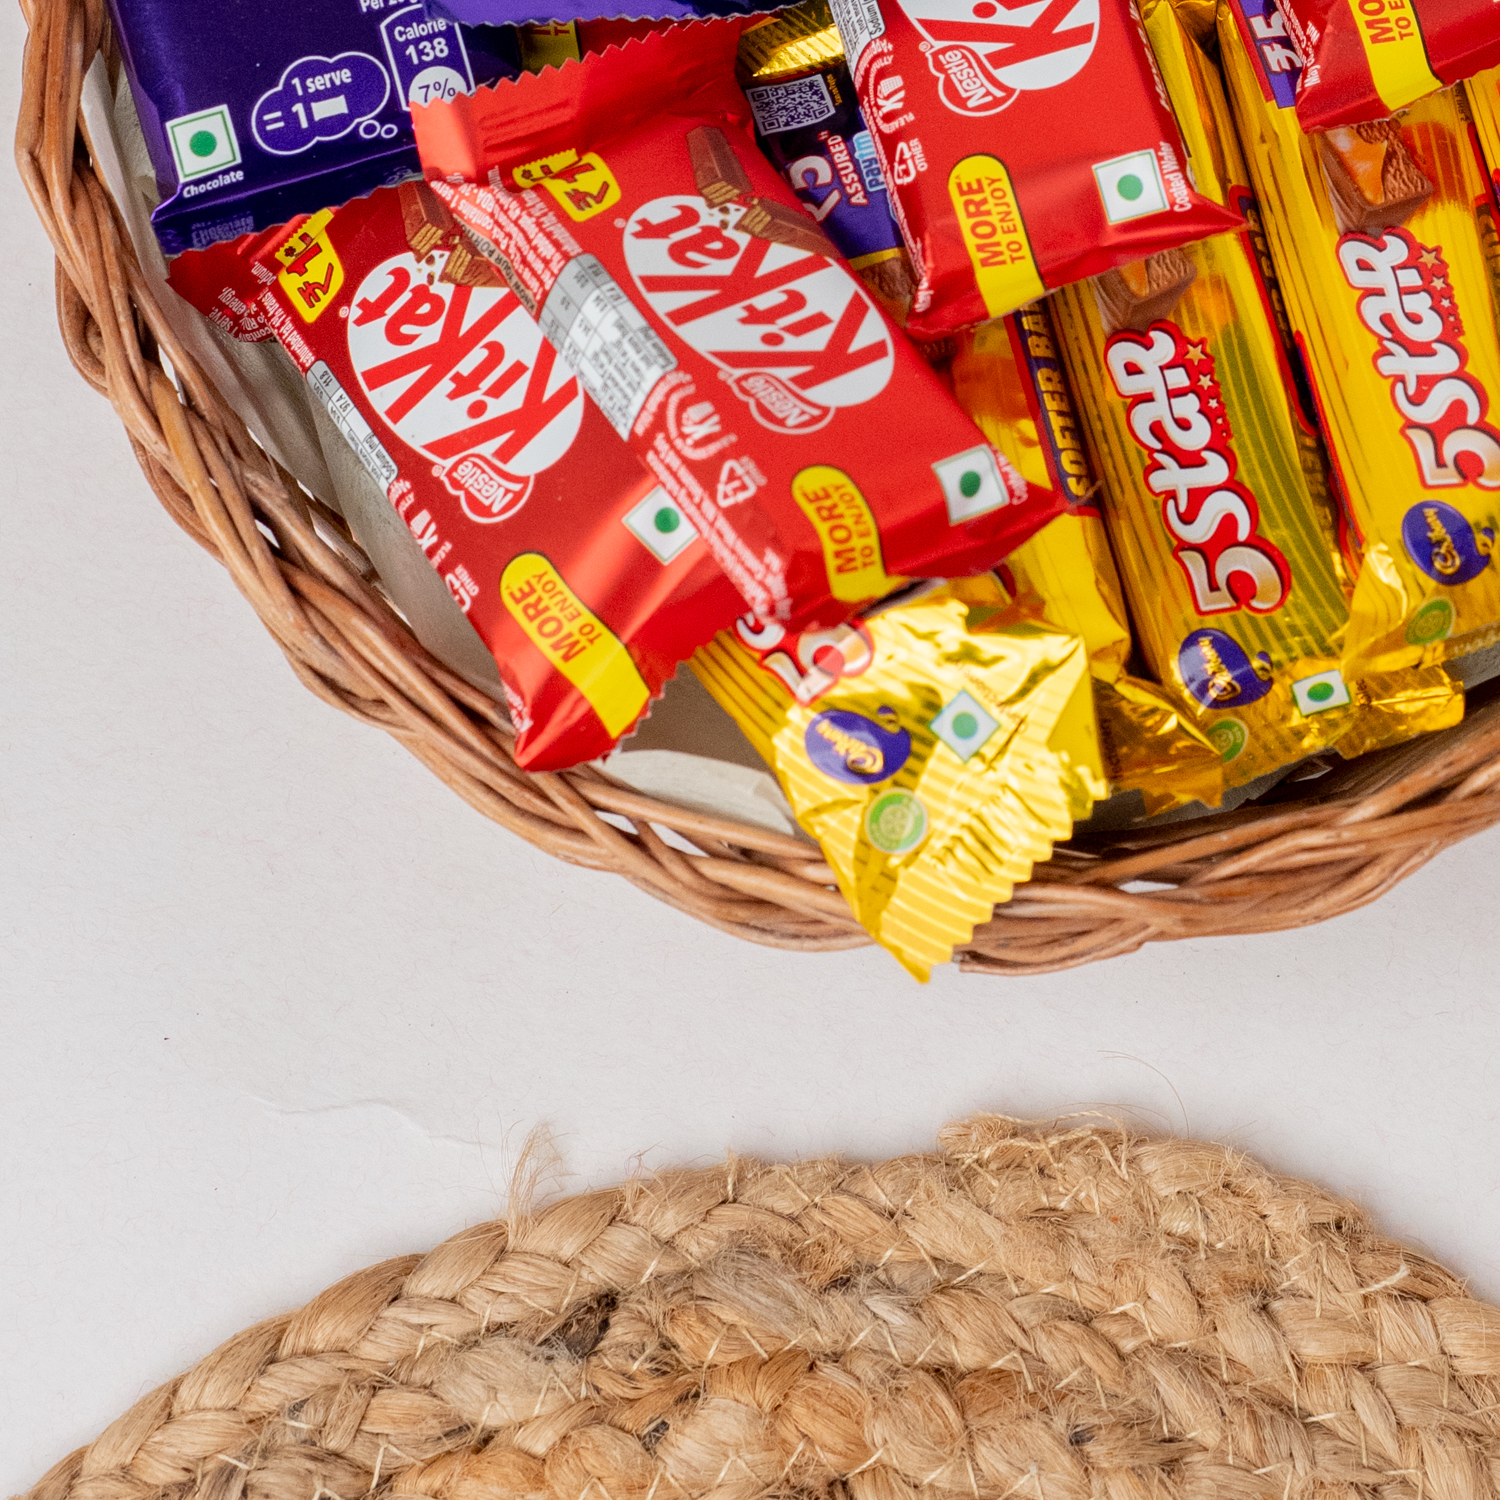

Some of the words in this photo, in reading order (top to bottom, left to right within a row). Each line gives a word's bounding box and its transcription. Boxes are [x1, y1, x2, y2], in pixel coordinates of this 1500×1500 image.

[394, 18, 447, 44] Calorie
[863, 4, 882, 34] Sodium
[1394, 14, 1414, 40] TO
[405, 38, 449, 64] 138
[306, 66, 352, 92] serve
[908, 137, 928, 172] OTHER
[1160, 142, 1181, 178] Wafer
[183, 169, 244, 198] Chocolate
[1173, 179, 1192, 212] Coated
[985, 172, 1017, 236] ENJOY
[1005, 238, 1026, 264] TO
[630, 213, 888, 398] KitKat
[354, 267, 582, 466] KitKat
[1035, 363, 1092, 499] SOFTER
[371, 448, 397, 479] Sodium
[832, 478, 871, 540] ENJOY
[854, 542, 879, 569] TO
[453, 562, 481, 597] OTHER
[532, 566, 582, 624] ENJOY
[577, 619, 603, 645] TO
